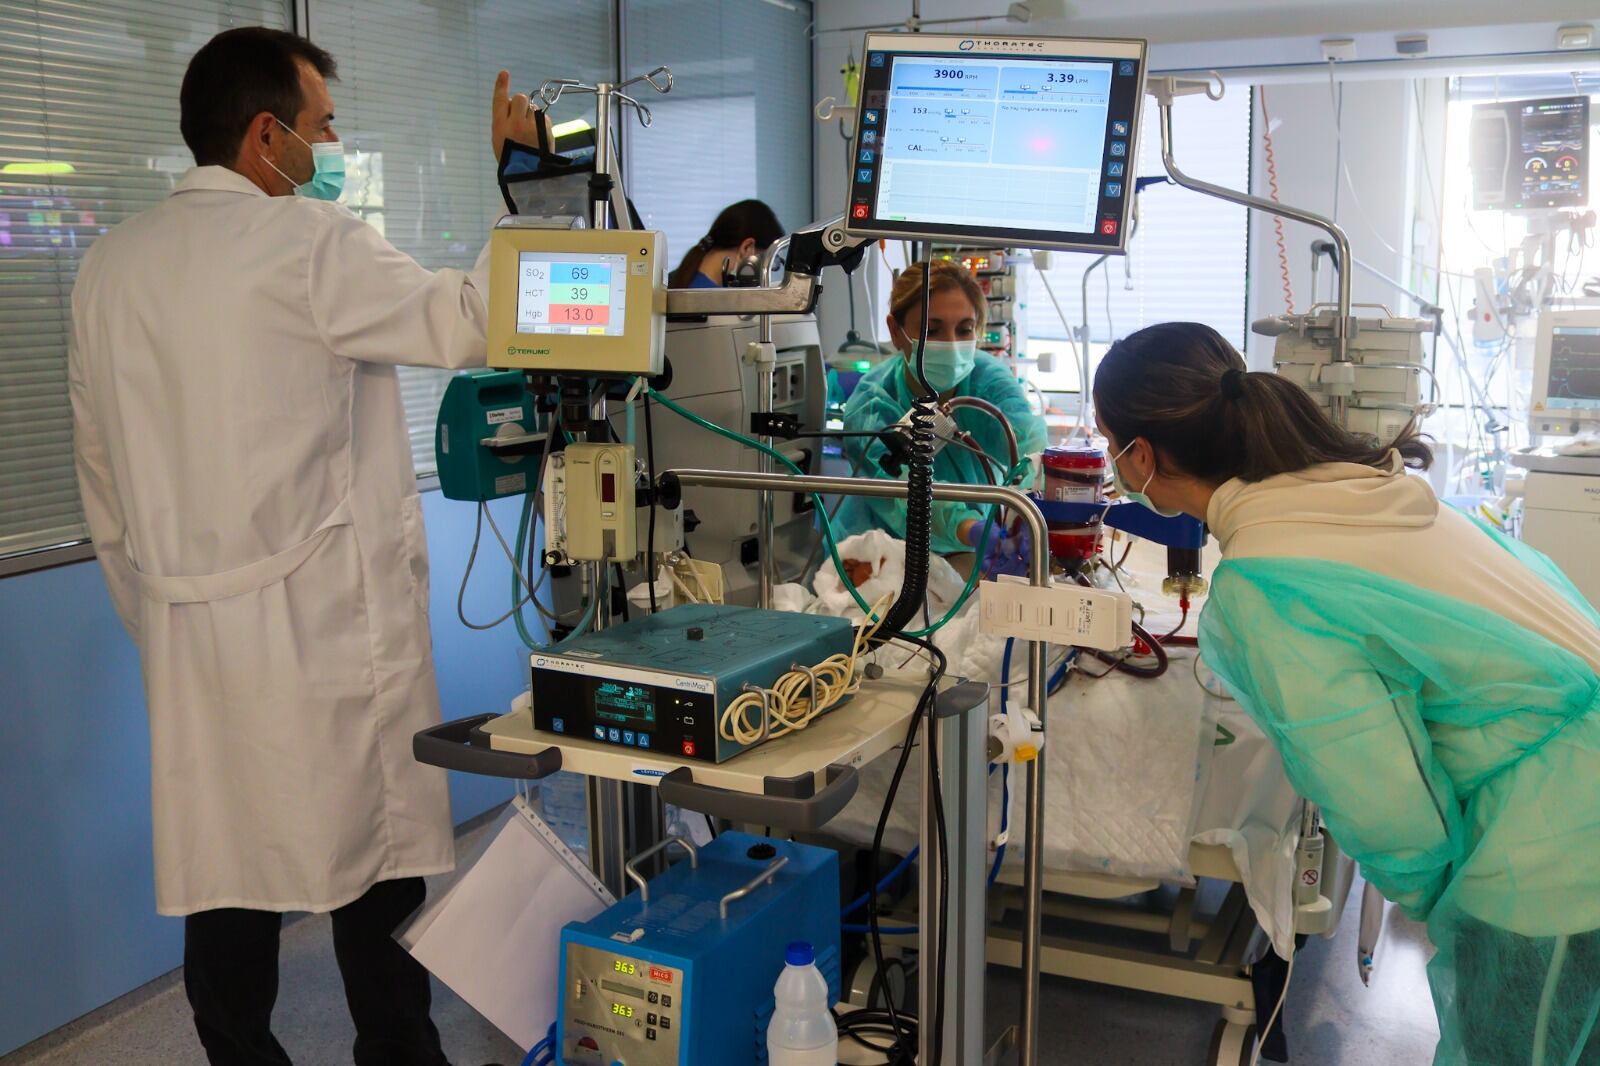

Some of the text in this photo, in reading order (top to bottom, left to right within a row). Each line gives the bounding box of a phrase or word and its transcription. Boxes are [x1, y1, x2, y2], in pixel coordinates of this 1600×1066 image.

[976, 40, 1044, 48] THORATEC
[933, 69, 964, 79] 3900
[1047, 73, 1075, 83] 3.39
[907, 144, 923, 152] CAL
[571, 267, 589, 280] 69
[525, 287, 588, 300] HCT 39
[525, 308, 594, 321] Hgb 13.0
